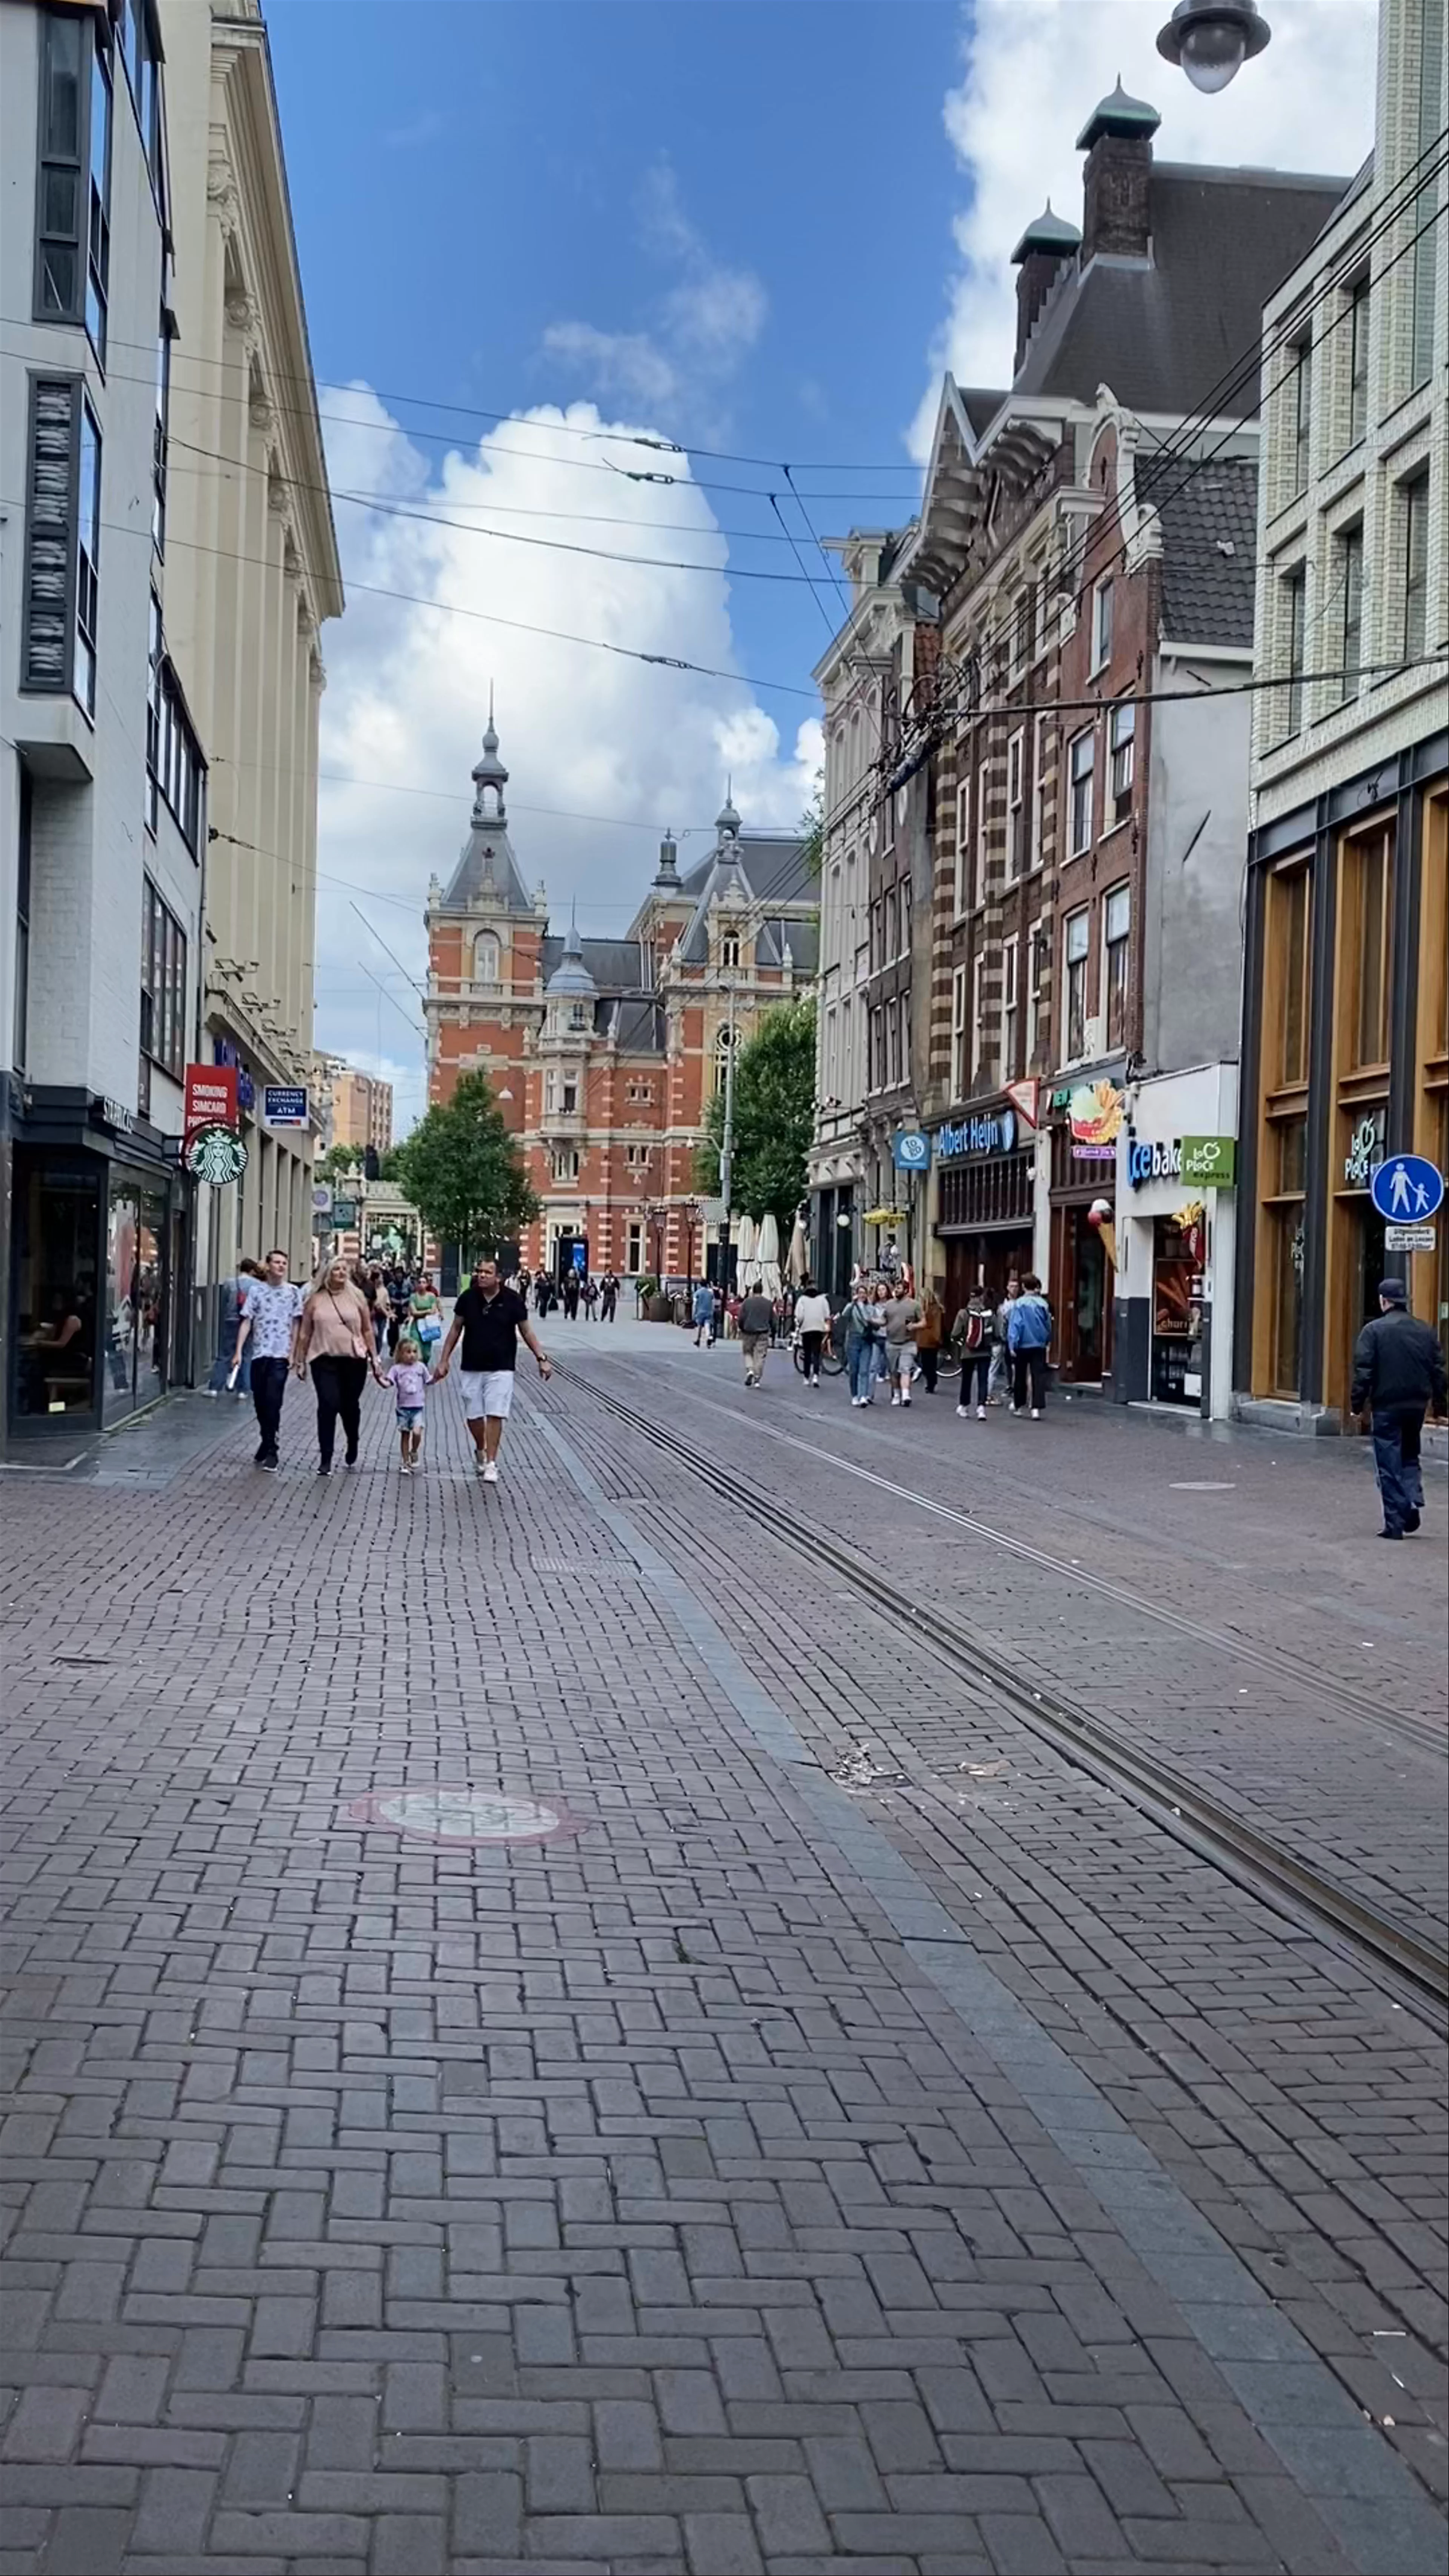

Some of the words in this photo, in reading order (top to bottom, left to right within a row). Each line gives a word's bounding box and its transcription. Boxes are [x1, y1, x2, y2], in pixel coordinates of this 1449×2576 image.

[192, 1083, 228, 1098] SMOKING
[192, 1100, 226, 1114] SIMCARD
[938, 1120, 968, 1157] Albert
[970, 1113, 998, 1154] Heijn
[906, 1140, 917, 1149] to
[1193, 1172, 1231, 1181] express
